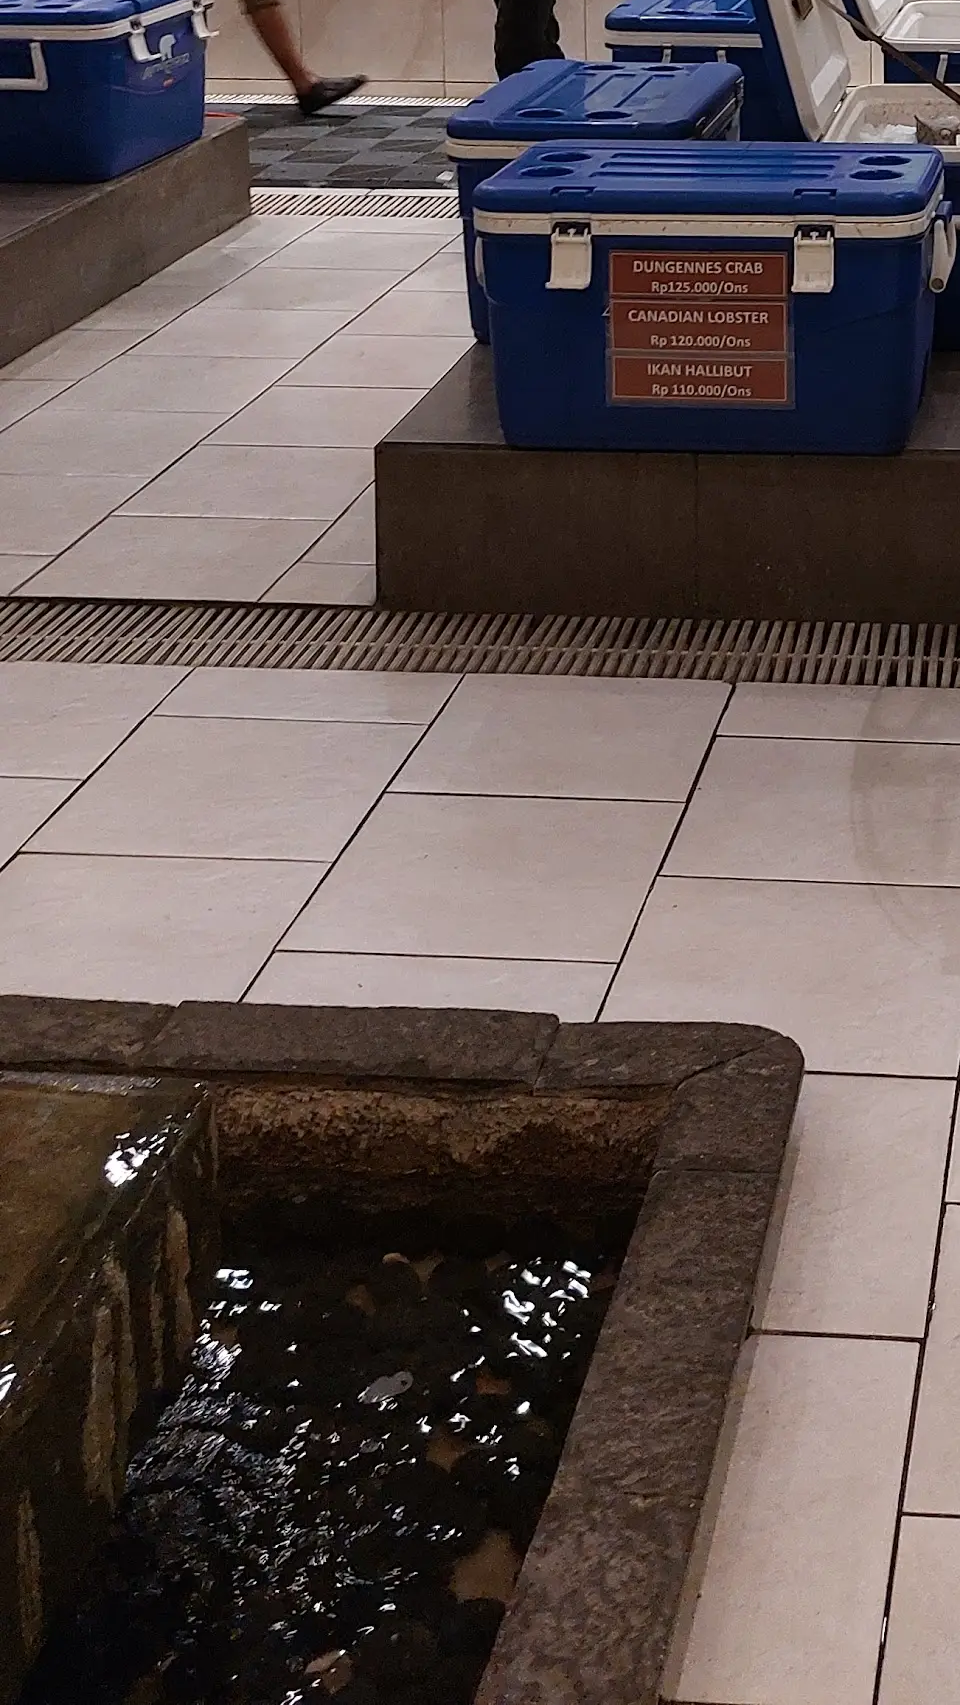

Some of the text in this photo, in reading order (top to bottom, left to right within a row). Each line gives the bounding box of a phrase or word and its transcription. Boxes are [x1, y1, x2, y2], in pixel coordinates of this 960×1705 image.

[633, 260, 764, 274] DUNGENNES CRAB
[651, 281, 749, 295] Rp125.000/Ons
[628, 309, 769, 323] CANADIAN LOBSTER
[650, 335, 751, 348] Rp 120.000/Ons
[647, 363, 752, 377] IKAN HALLIBUT
[651, 384, 752, 397] Rp 110.000/Ons
